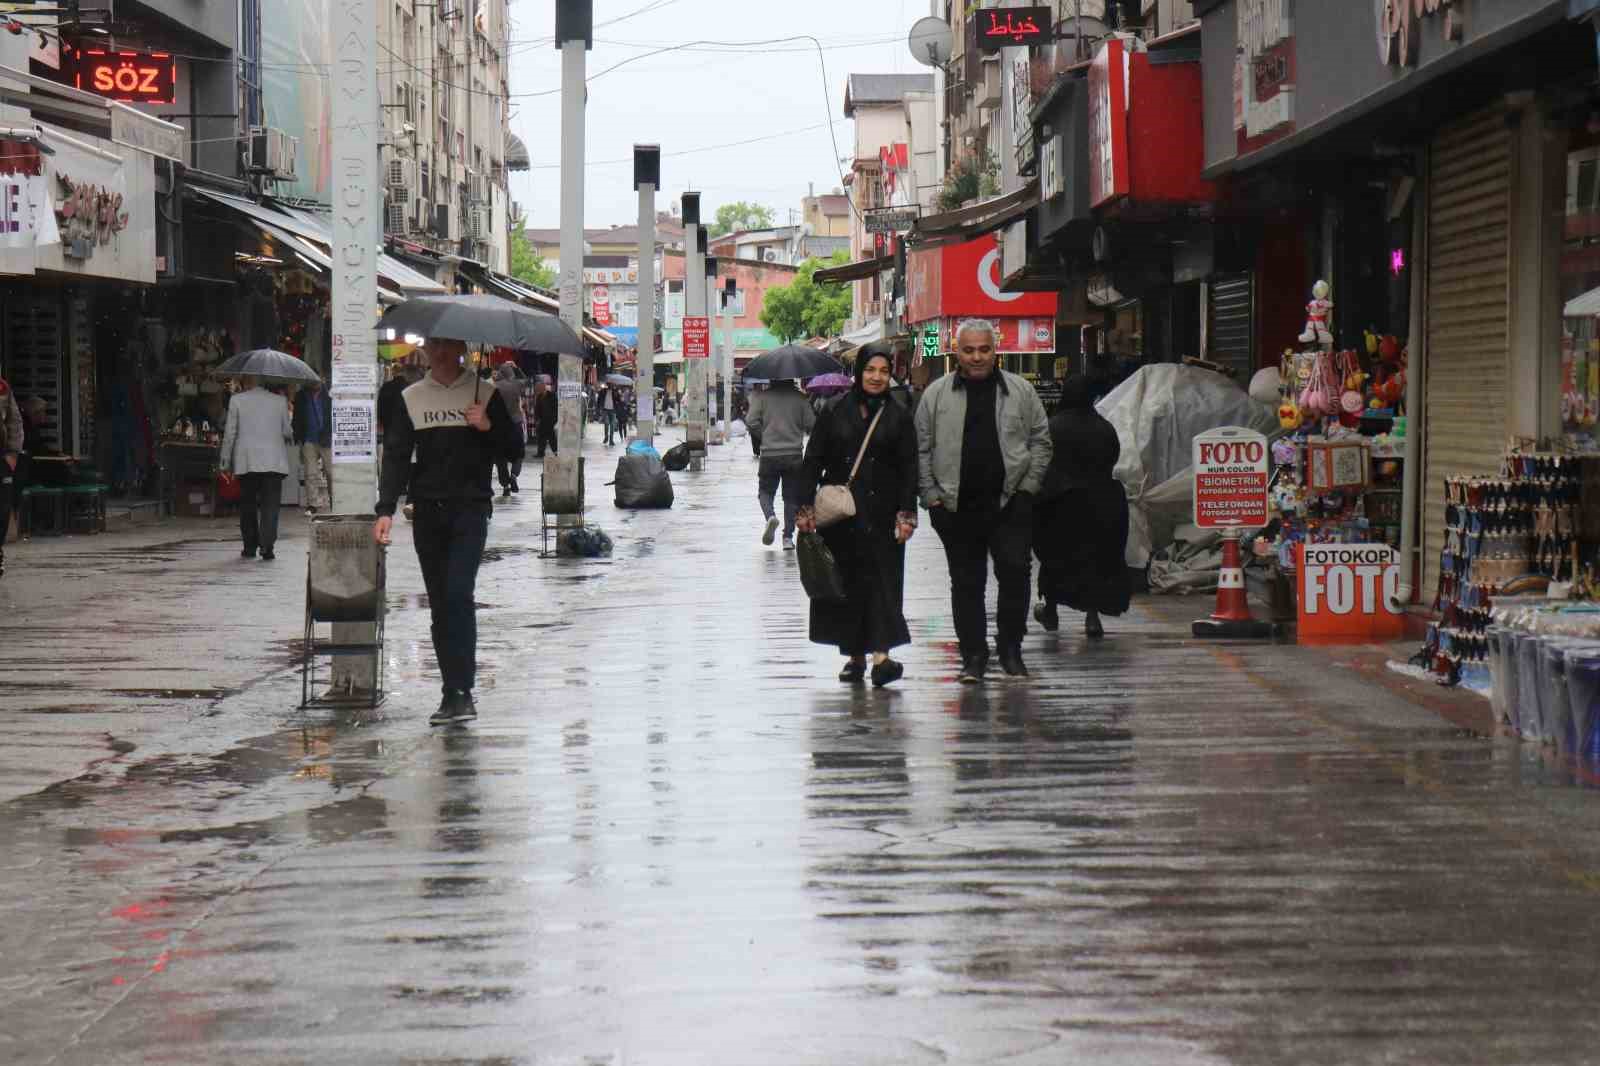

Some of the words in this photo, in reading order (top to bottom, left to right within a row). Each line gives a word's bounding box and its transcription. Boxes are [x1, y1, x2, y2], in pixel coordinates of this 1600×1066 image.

[985, 12, 1040, 42] خياط
[94, 62, 159, 92] SÖZ
[423, 409, 465, 423] BOSS
[1199, 442, 1263, 464] FOTO
